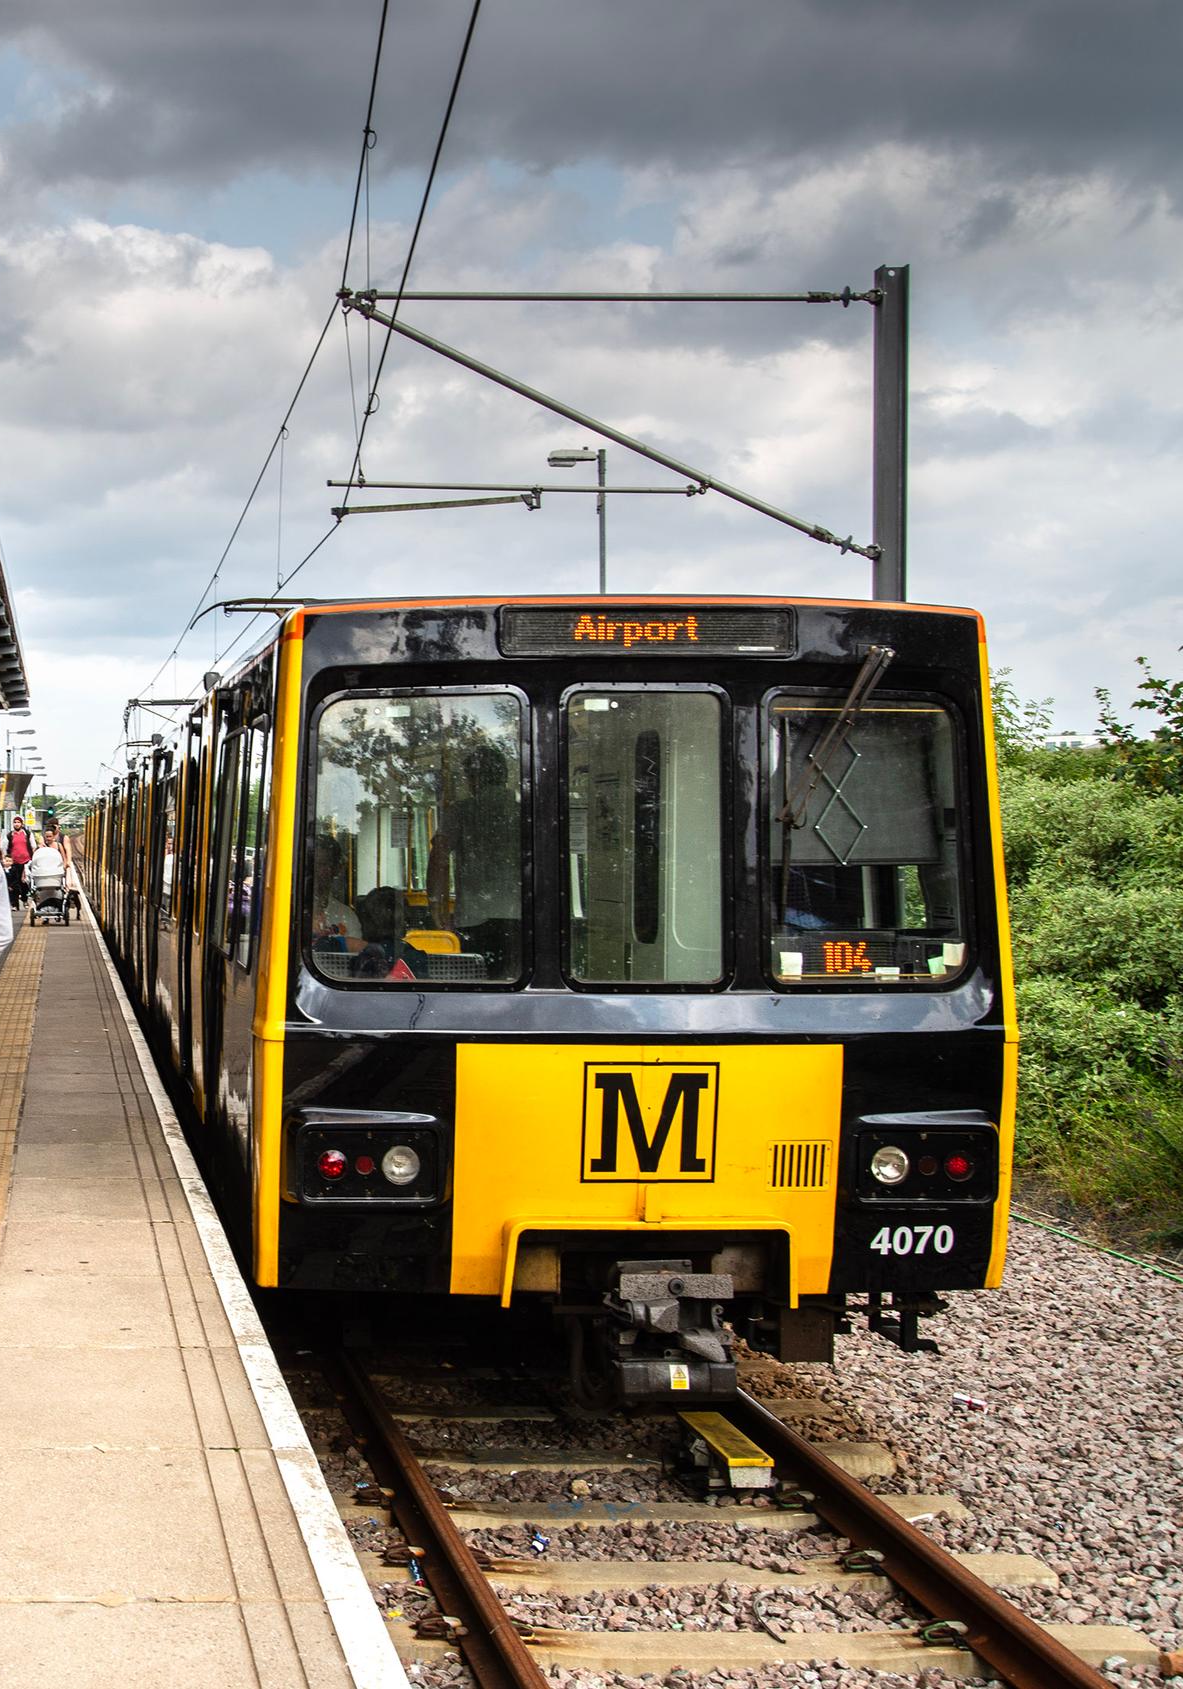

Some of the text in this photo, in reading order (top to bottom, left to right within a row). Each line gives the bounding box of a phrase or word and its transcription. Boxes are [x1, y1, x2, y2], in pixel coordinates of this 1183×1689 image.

[574, 615, 699, 648] Airport
[822, 941, 873, 974] 104
[590, 1072, 710, 1173] M
[869, 1224, 955, 1256] 4070
